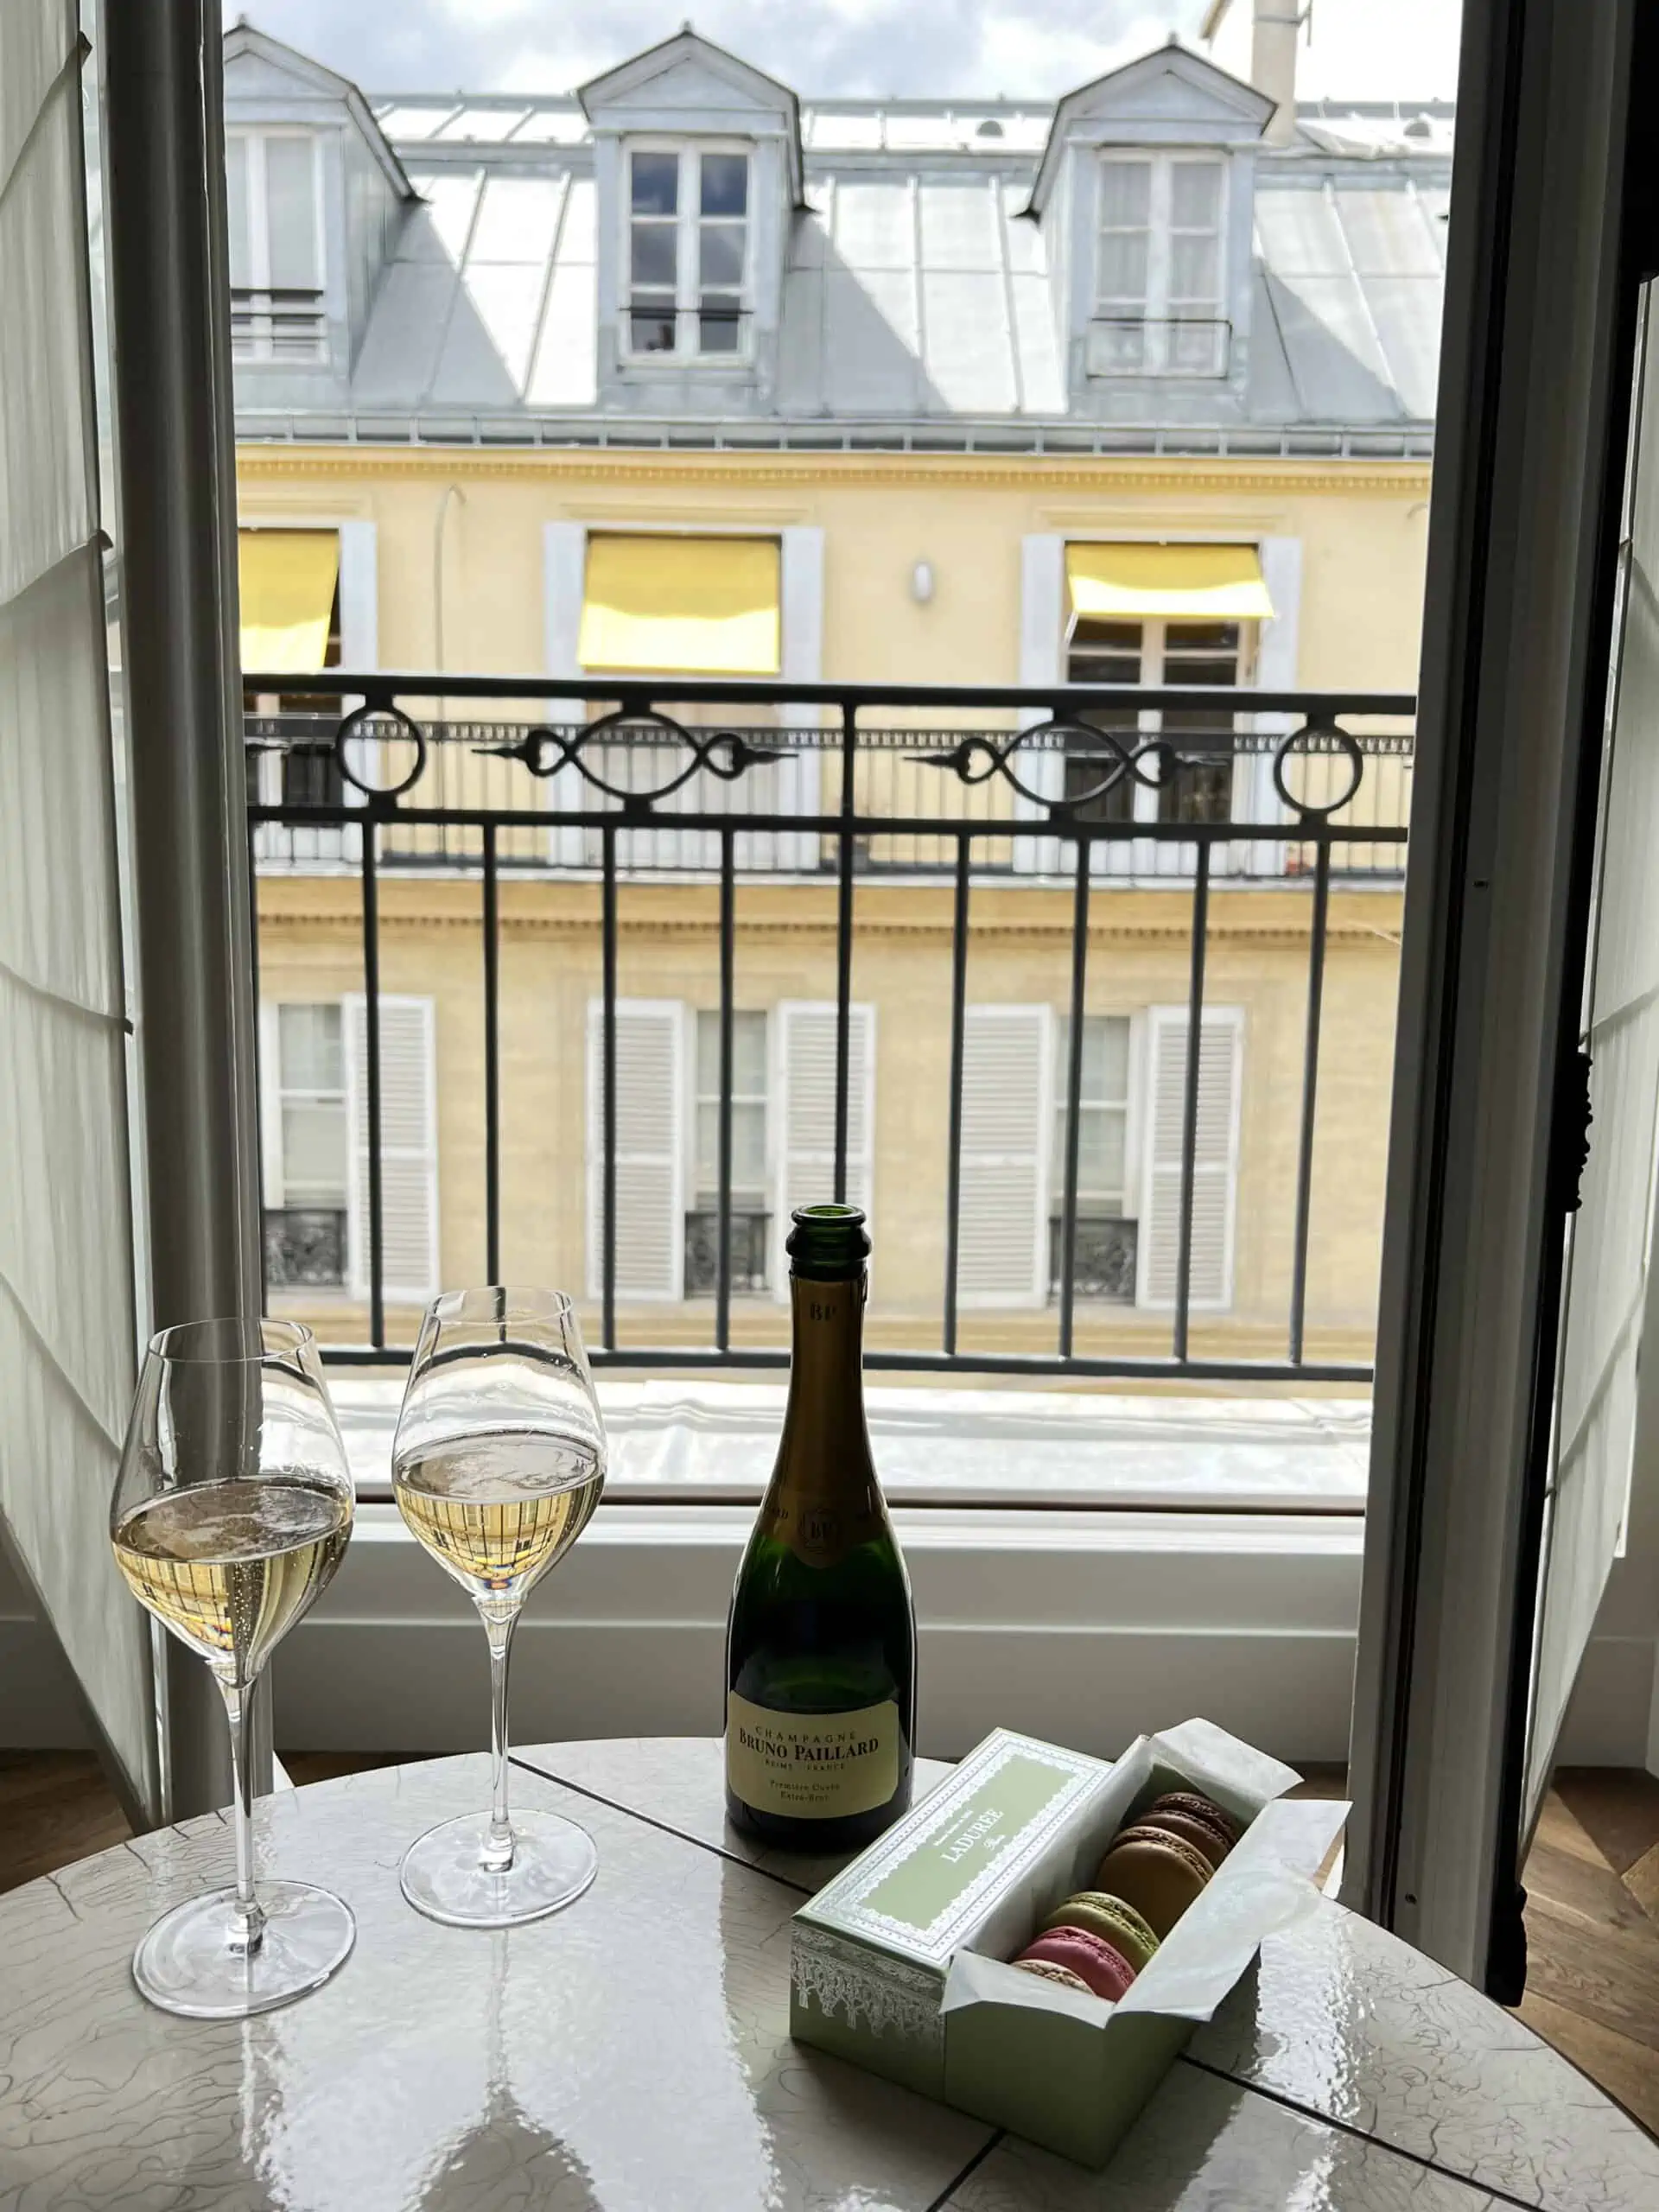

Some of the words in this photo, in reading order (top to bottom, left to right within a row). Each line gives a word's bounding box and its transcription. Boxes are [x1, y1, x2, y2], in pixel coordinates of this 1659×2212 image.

[810, 1302, 836, 1321] BP
[740, 1726, 787, 1758] BRUNO
[795, 1738, 879, 1761] PAILLARD
[755, 1726, 856, 1743] CHAMPAGNE
